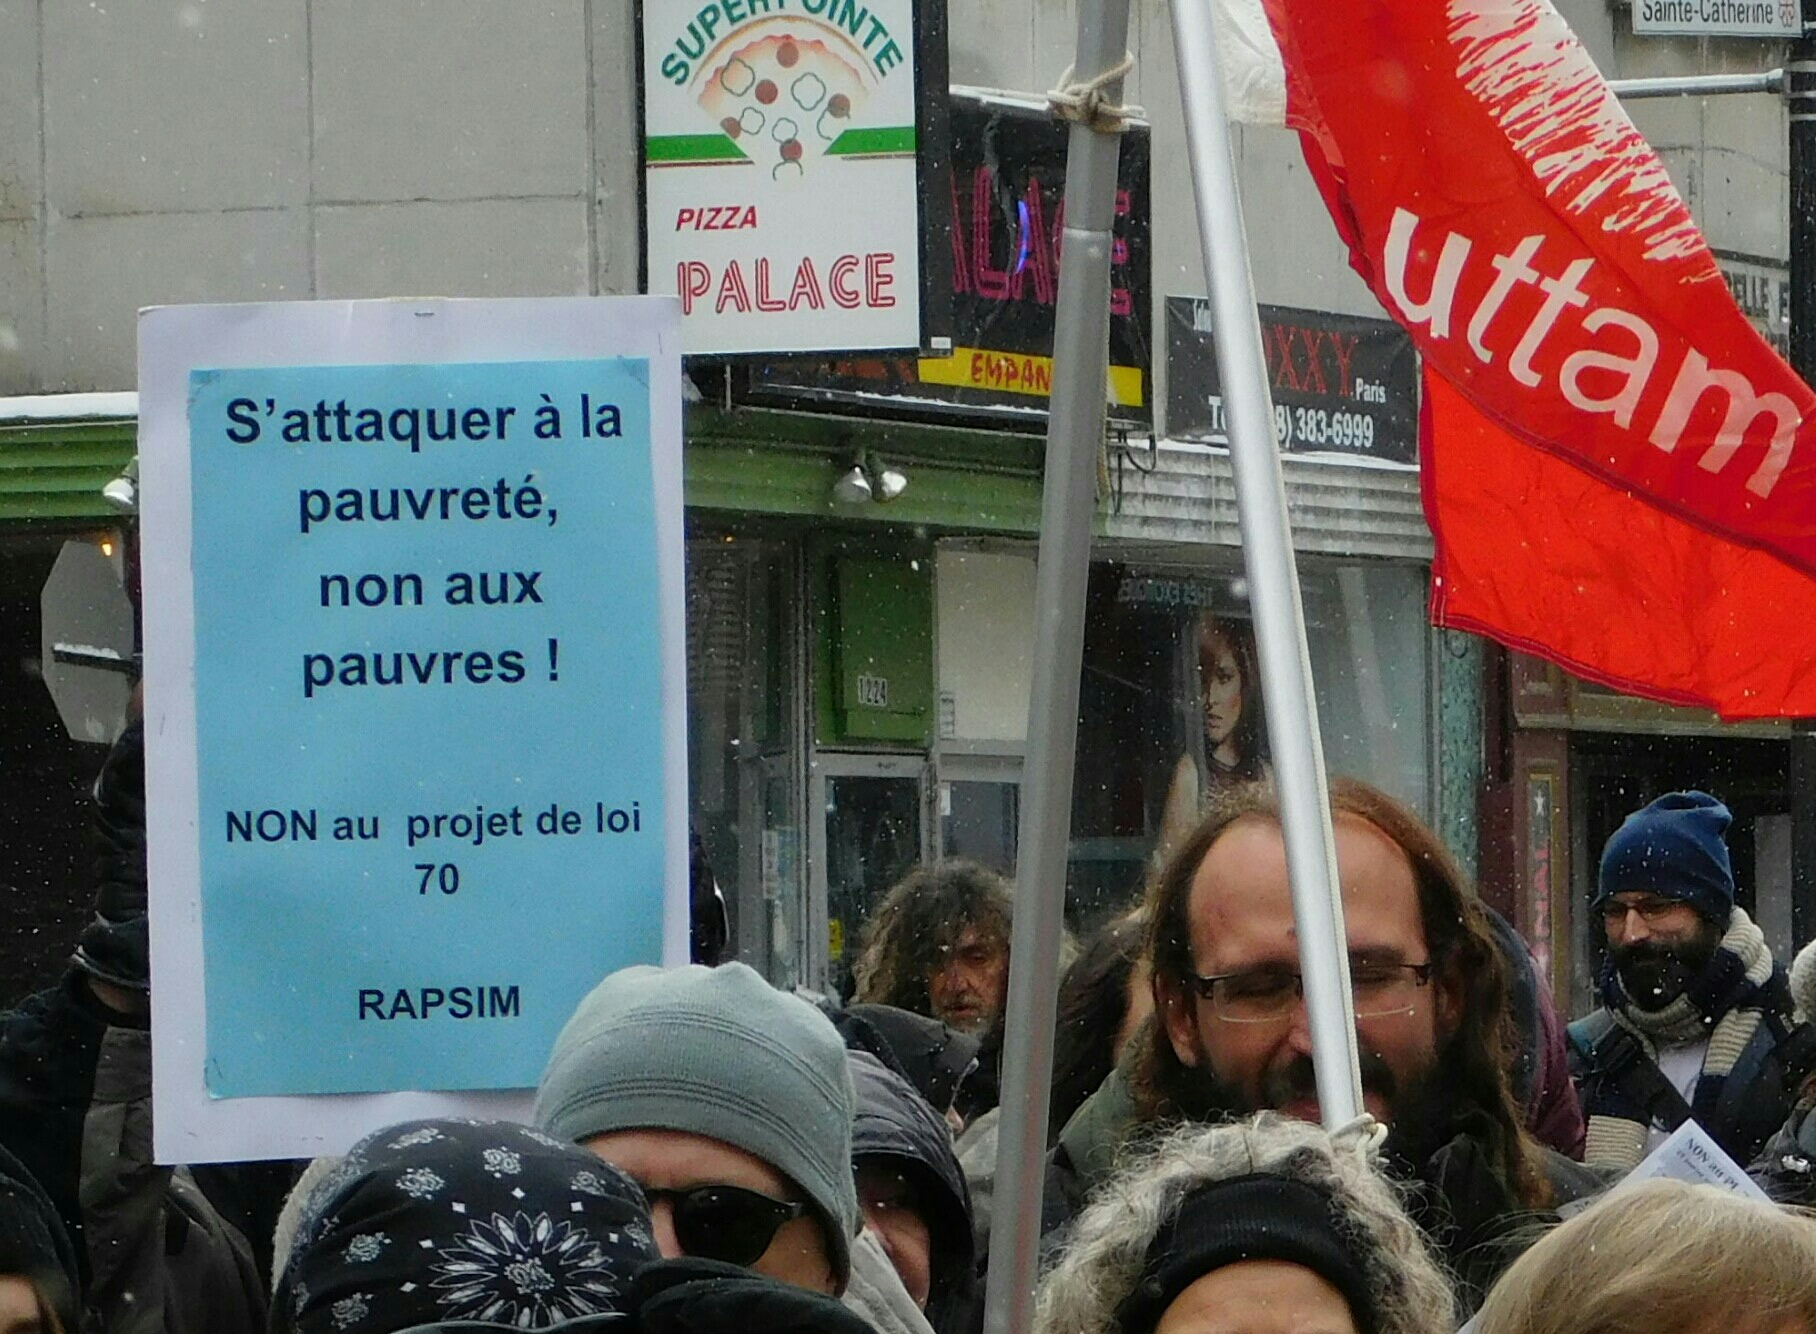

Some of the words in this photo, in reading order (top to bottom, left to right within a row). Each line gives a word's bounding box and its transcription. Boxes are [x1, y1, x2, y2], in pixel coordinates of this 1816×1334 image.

[1642, 0, 1773, 24] Sainte-Catherine
[675, 206, 758, 231] PIZZA
[677, 253, 896, 316] PALACE
[970, 353, 1053, 393] EMPAN
[1383, 206, 1802, 500] uttam
[226, 397, 516, 453] S’attaquer
[533, 393, 561, 439] à
[580, 393, 623, 438] la
[1296, 407, 1374, 448] 383-6999
[299, 473, 558, 533] pauvreté,
[320, 571, 423, 607] non
[445, 569, 544, 605] aux
[303, 648, 526, 698] pauvres
[547, 637, 560, 682] !
[857, 675, 888, 707] 1224
[226, 809, 318, 842] NON
[333, 815, 380, 840] au
[406, 806, 523, 847] projet
[536, 803, 582, 836] de
[596, 801, 642, 833] loi
[414, 863, 460, 896] 70
[358, 985, 521, 1020] RAPSIM
